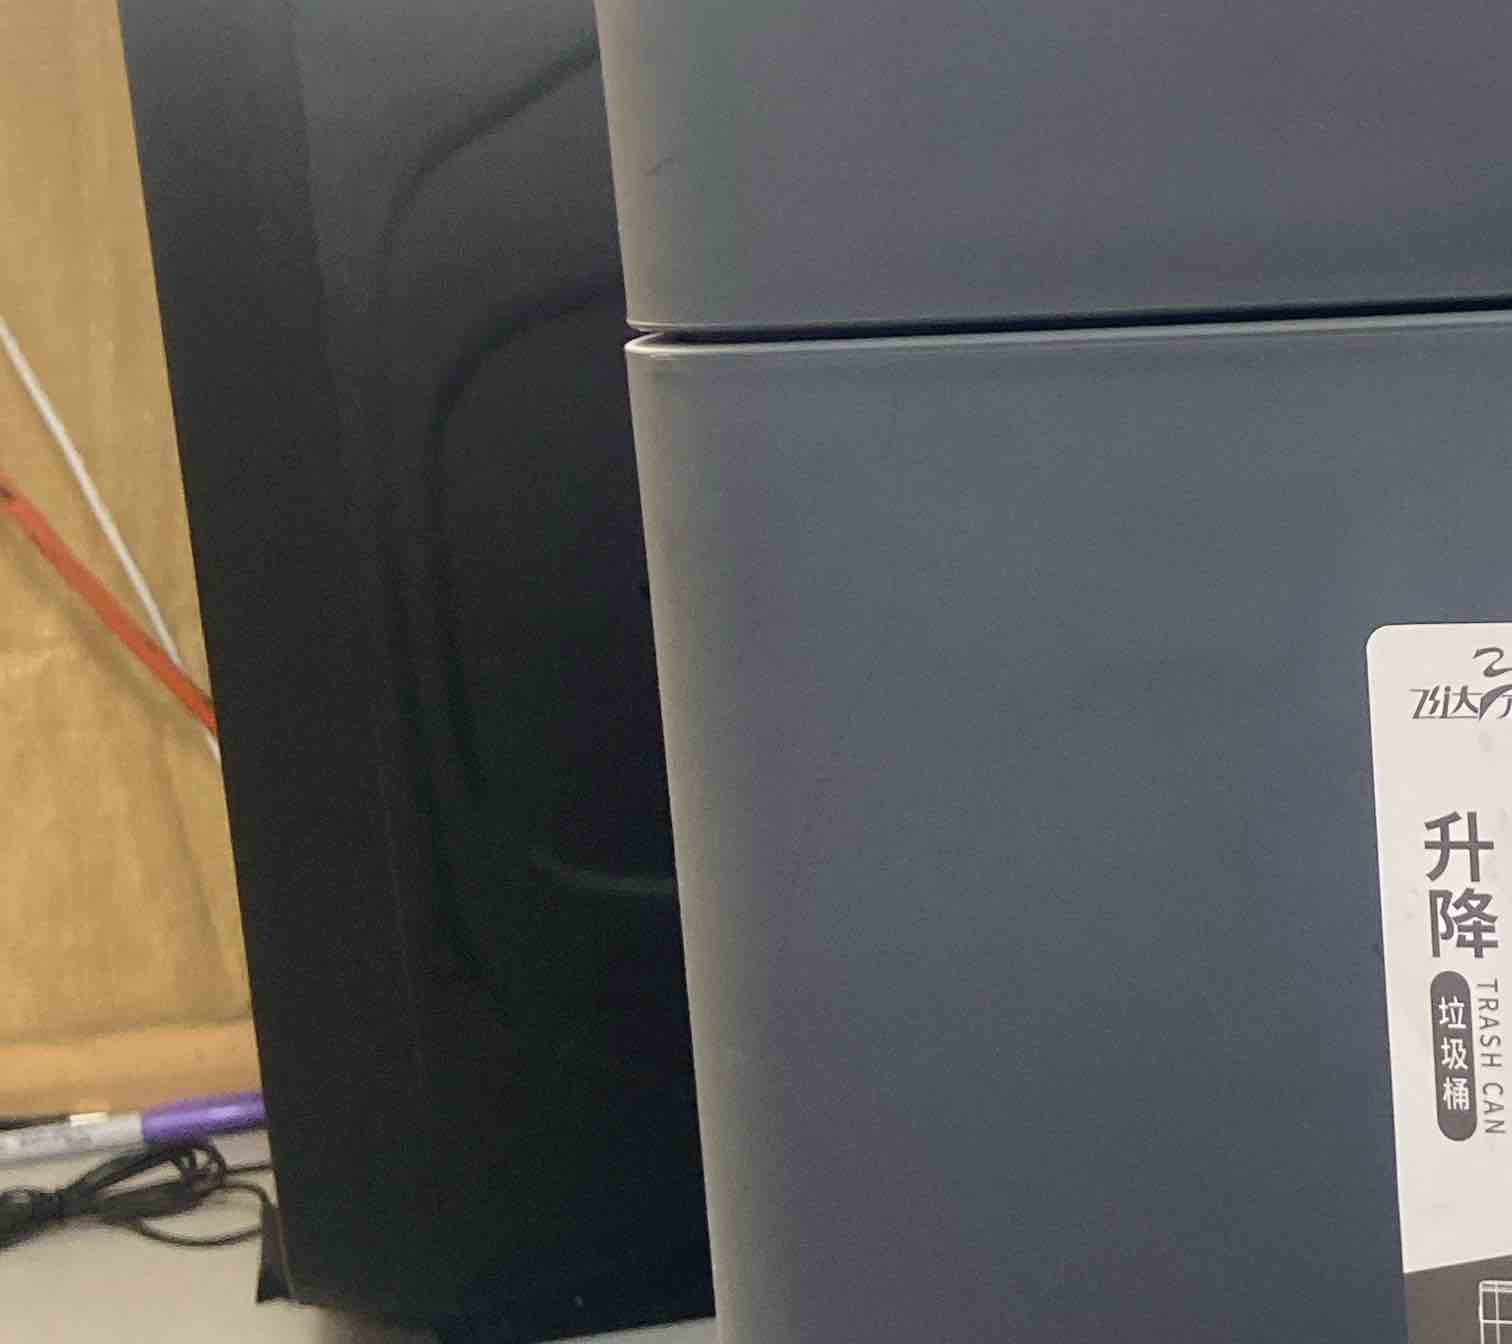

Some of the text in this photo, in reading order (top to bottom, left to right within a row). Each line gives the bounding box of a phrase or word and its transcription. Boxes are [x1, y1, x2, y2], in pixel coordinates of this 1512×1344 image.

[1423, 810, 1499, 959] 升降
[1437, 994, 1471, 1112] 垃圾桶
[1475, 977, 1506, 1136] TRASH CAN
